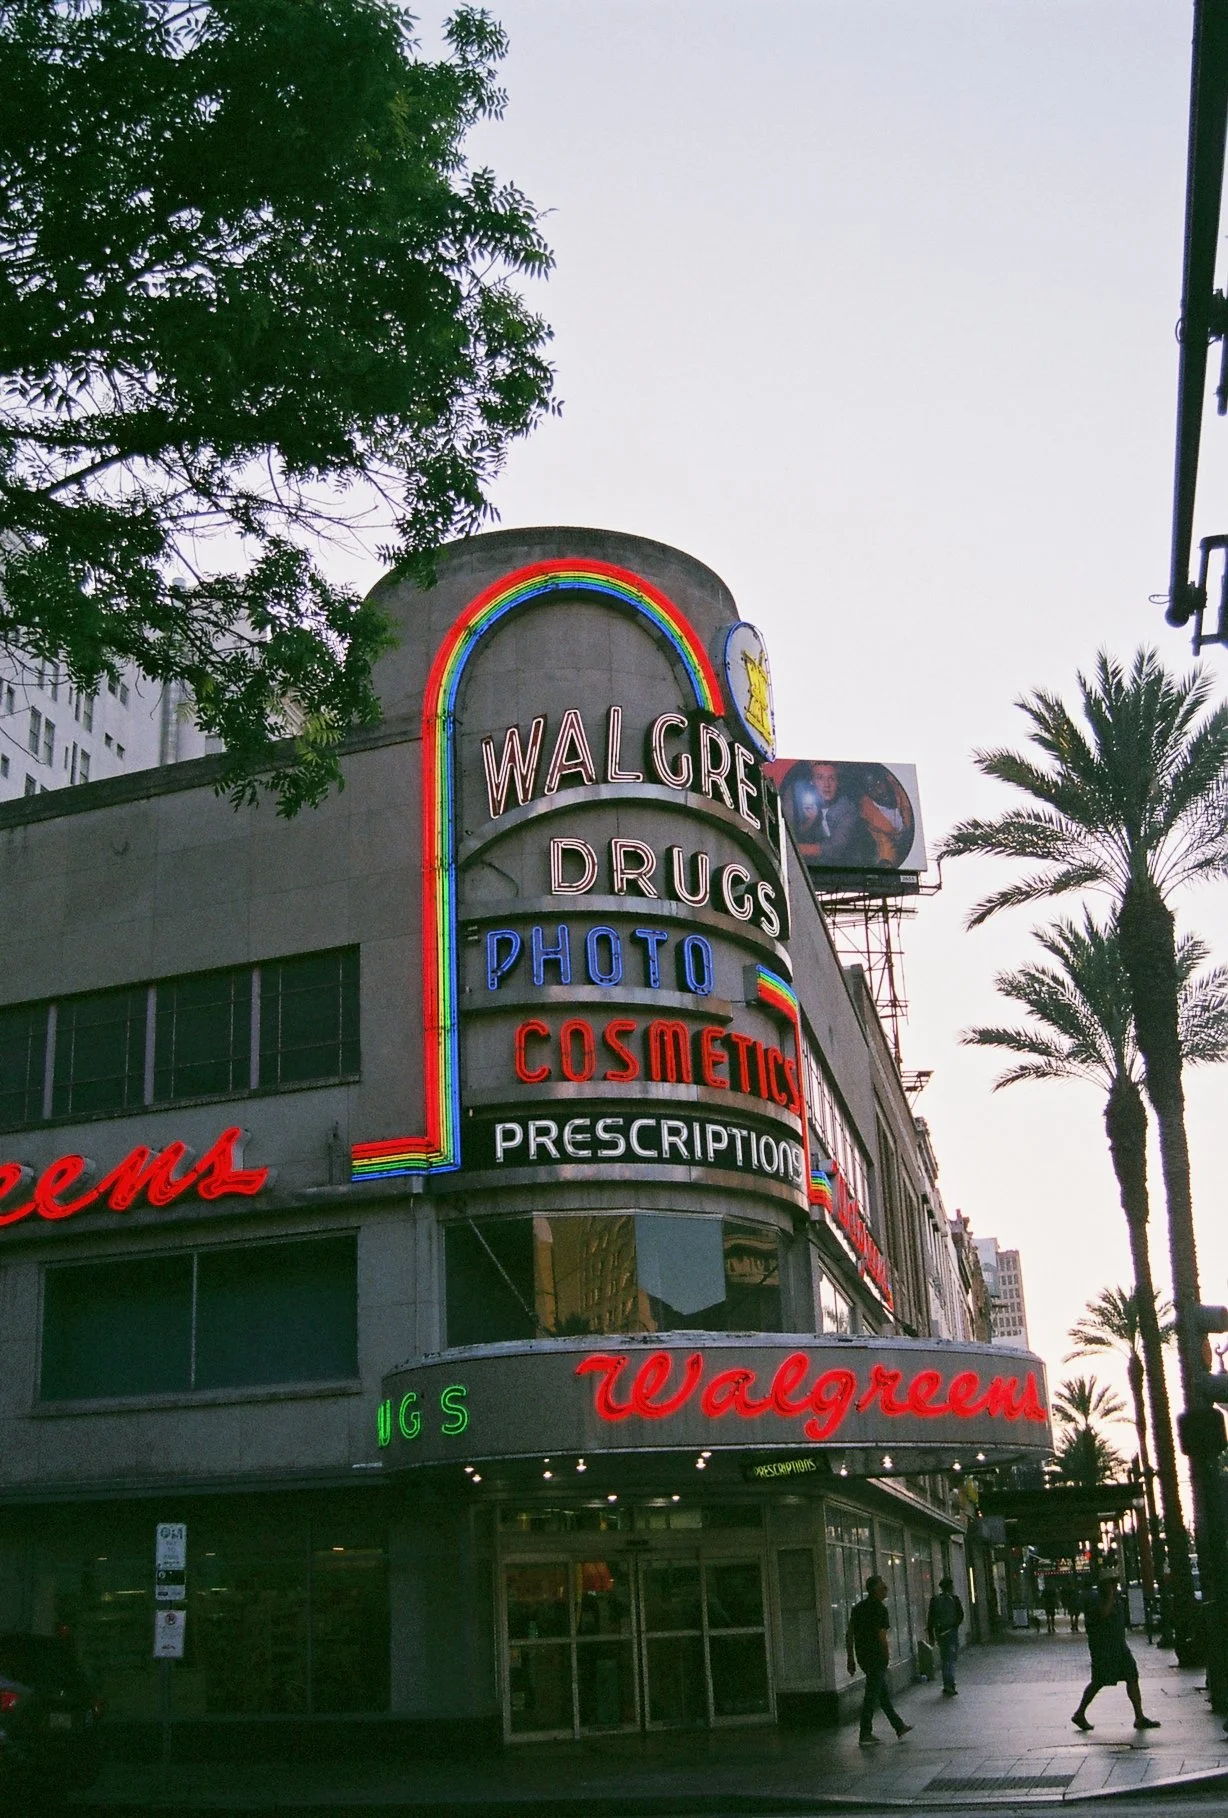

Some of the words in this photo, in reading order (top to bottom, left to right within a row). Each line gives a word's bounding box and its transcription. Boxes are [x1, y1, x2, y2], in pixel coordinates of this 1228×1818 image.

[551, 838, 779, 937] DRUGS
[487, 925, 714, 996] PHOTO
[514, 1018, 800, 1114] COSMETICS
[495, 1118, 803, 1182] PRESCRIPTIONS
[576, 1351, 1047, 1440] Walgreens
[754, 1459, 817, 1478] PRESCRIPTIONS
